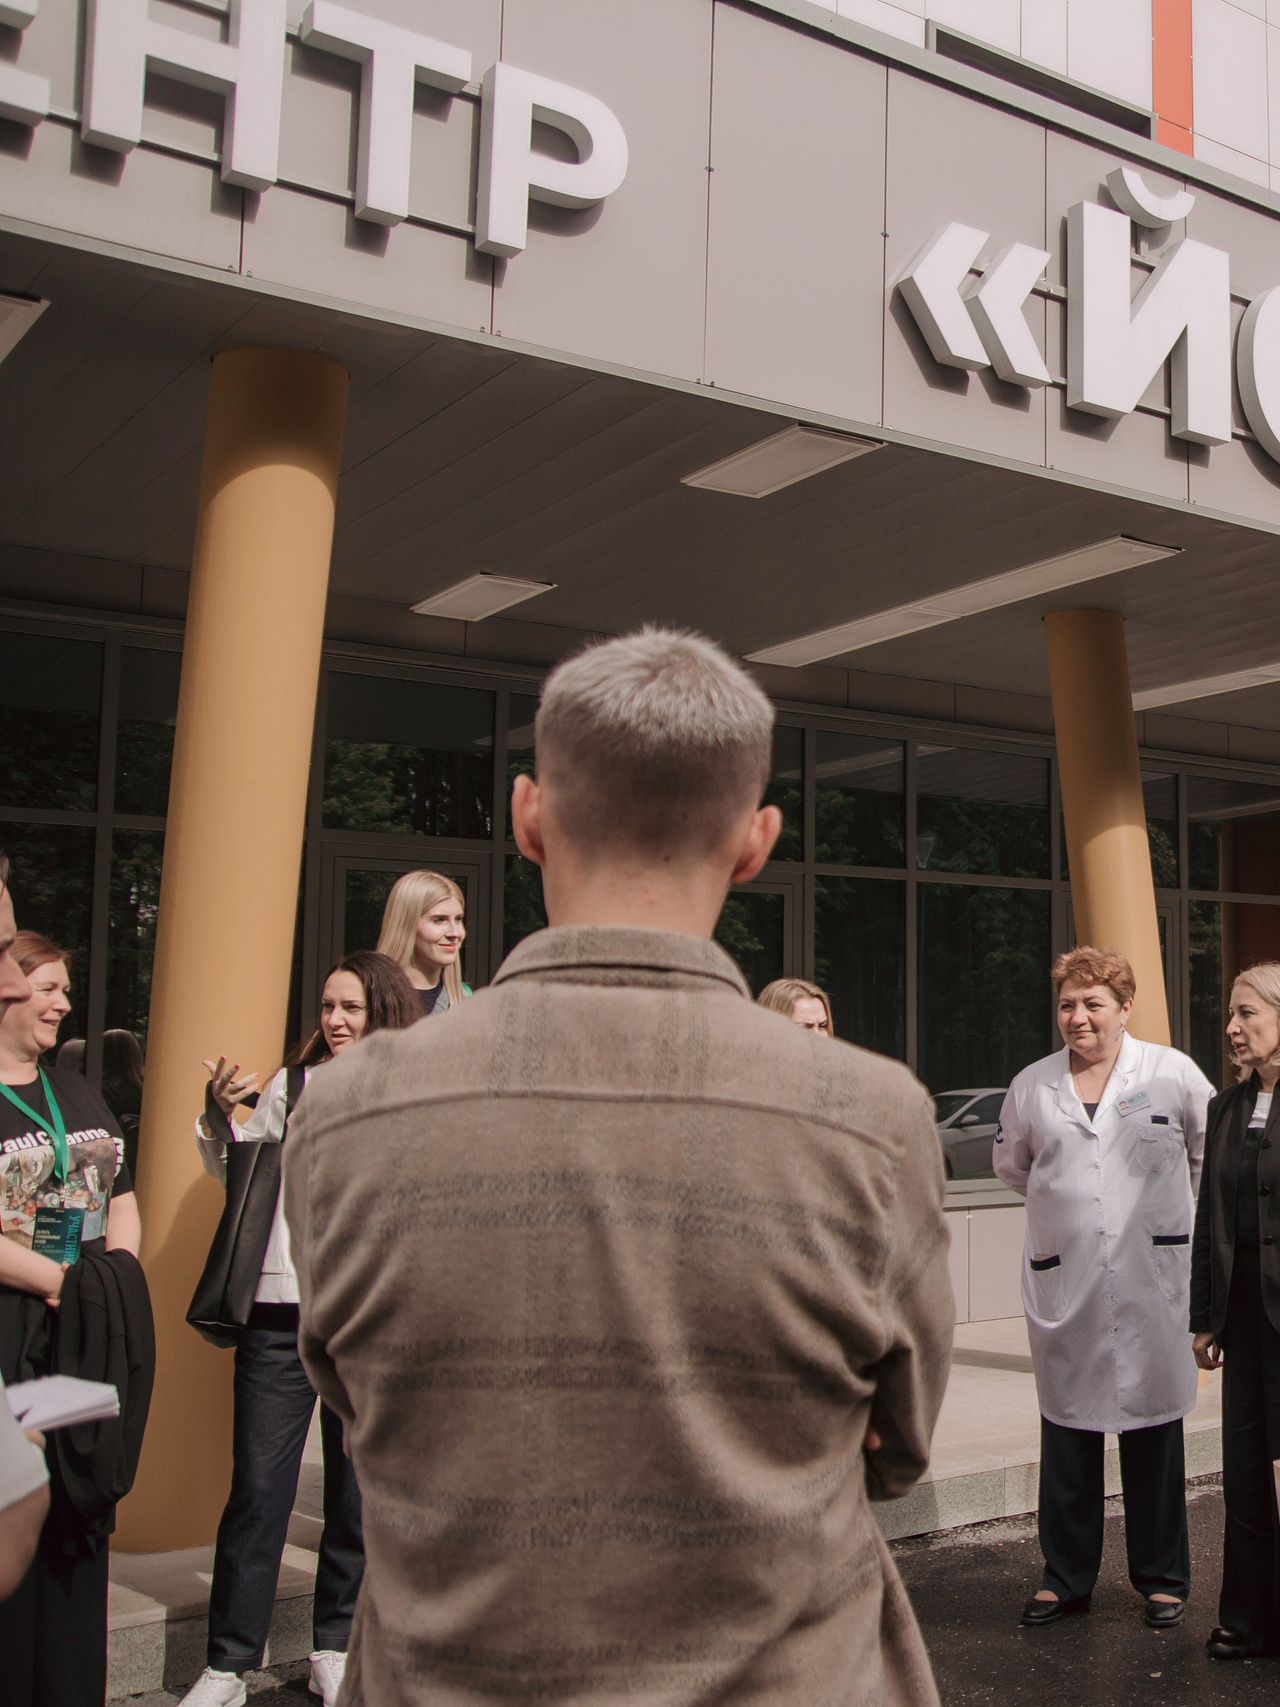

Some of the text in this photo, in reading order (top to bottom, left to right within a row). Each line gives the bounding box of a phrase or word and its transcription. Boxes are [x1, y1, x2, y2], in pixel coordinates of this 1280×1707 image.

[0, 0, 628, 258] НТР
[0, 1128, 110, 1153] aul Canne
